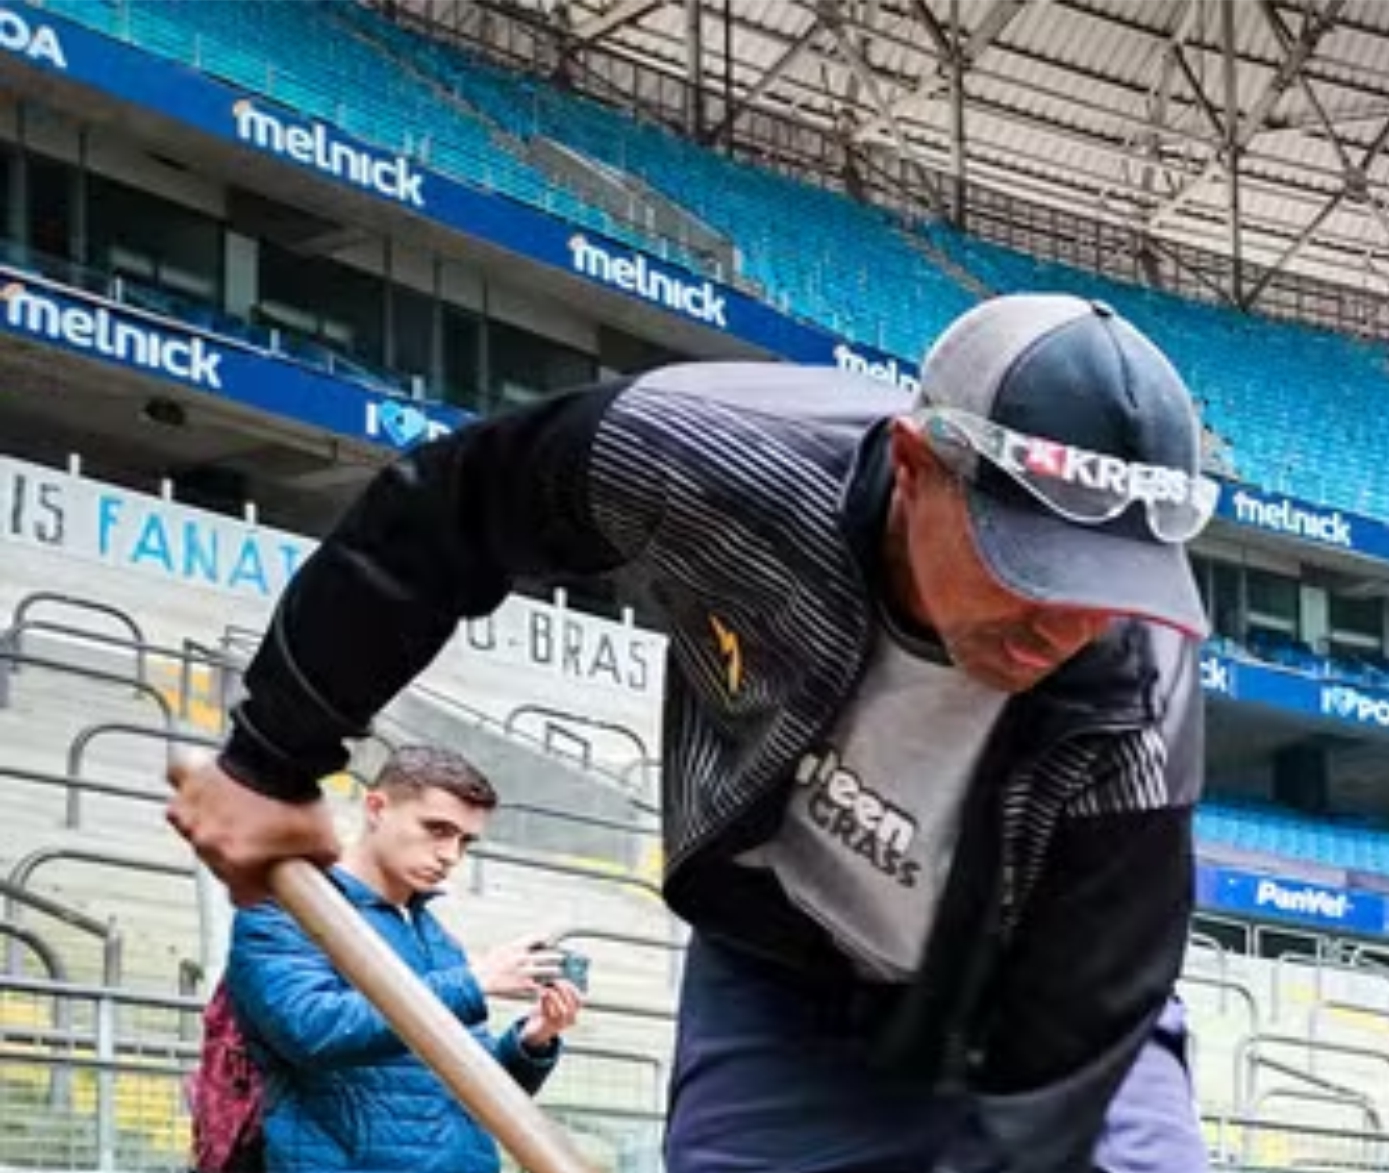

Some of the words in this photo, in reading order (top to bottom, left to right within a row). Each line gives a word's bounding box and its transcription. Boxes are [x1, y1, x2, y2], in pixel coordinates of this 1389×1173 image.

[0, 7, 68, 68] OA
[233, 100, 425, 207] melnick
[567, 234, 728, 330] melnick
[4, 282, 222, 390] melnick
[834, 344, 921, 391] meln
[10, 474, 64, 545] IS
[98, 493, 300, 596] FANÁT
[1233, 490, 1352, 548] melnick
[531, 612, 648, 691] BRAS
[807, 788, 922, 889] GRASS
[1255, 879, 1348, 918] PanVel
